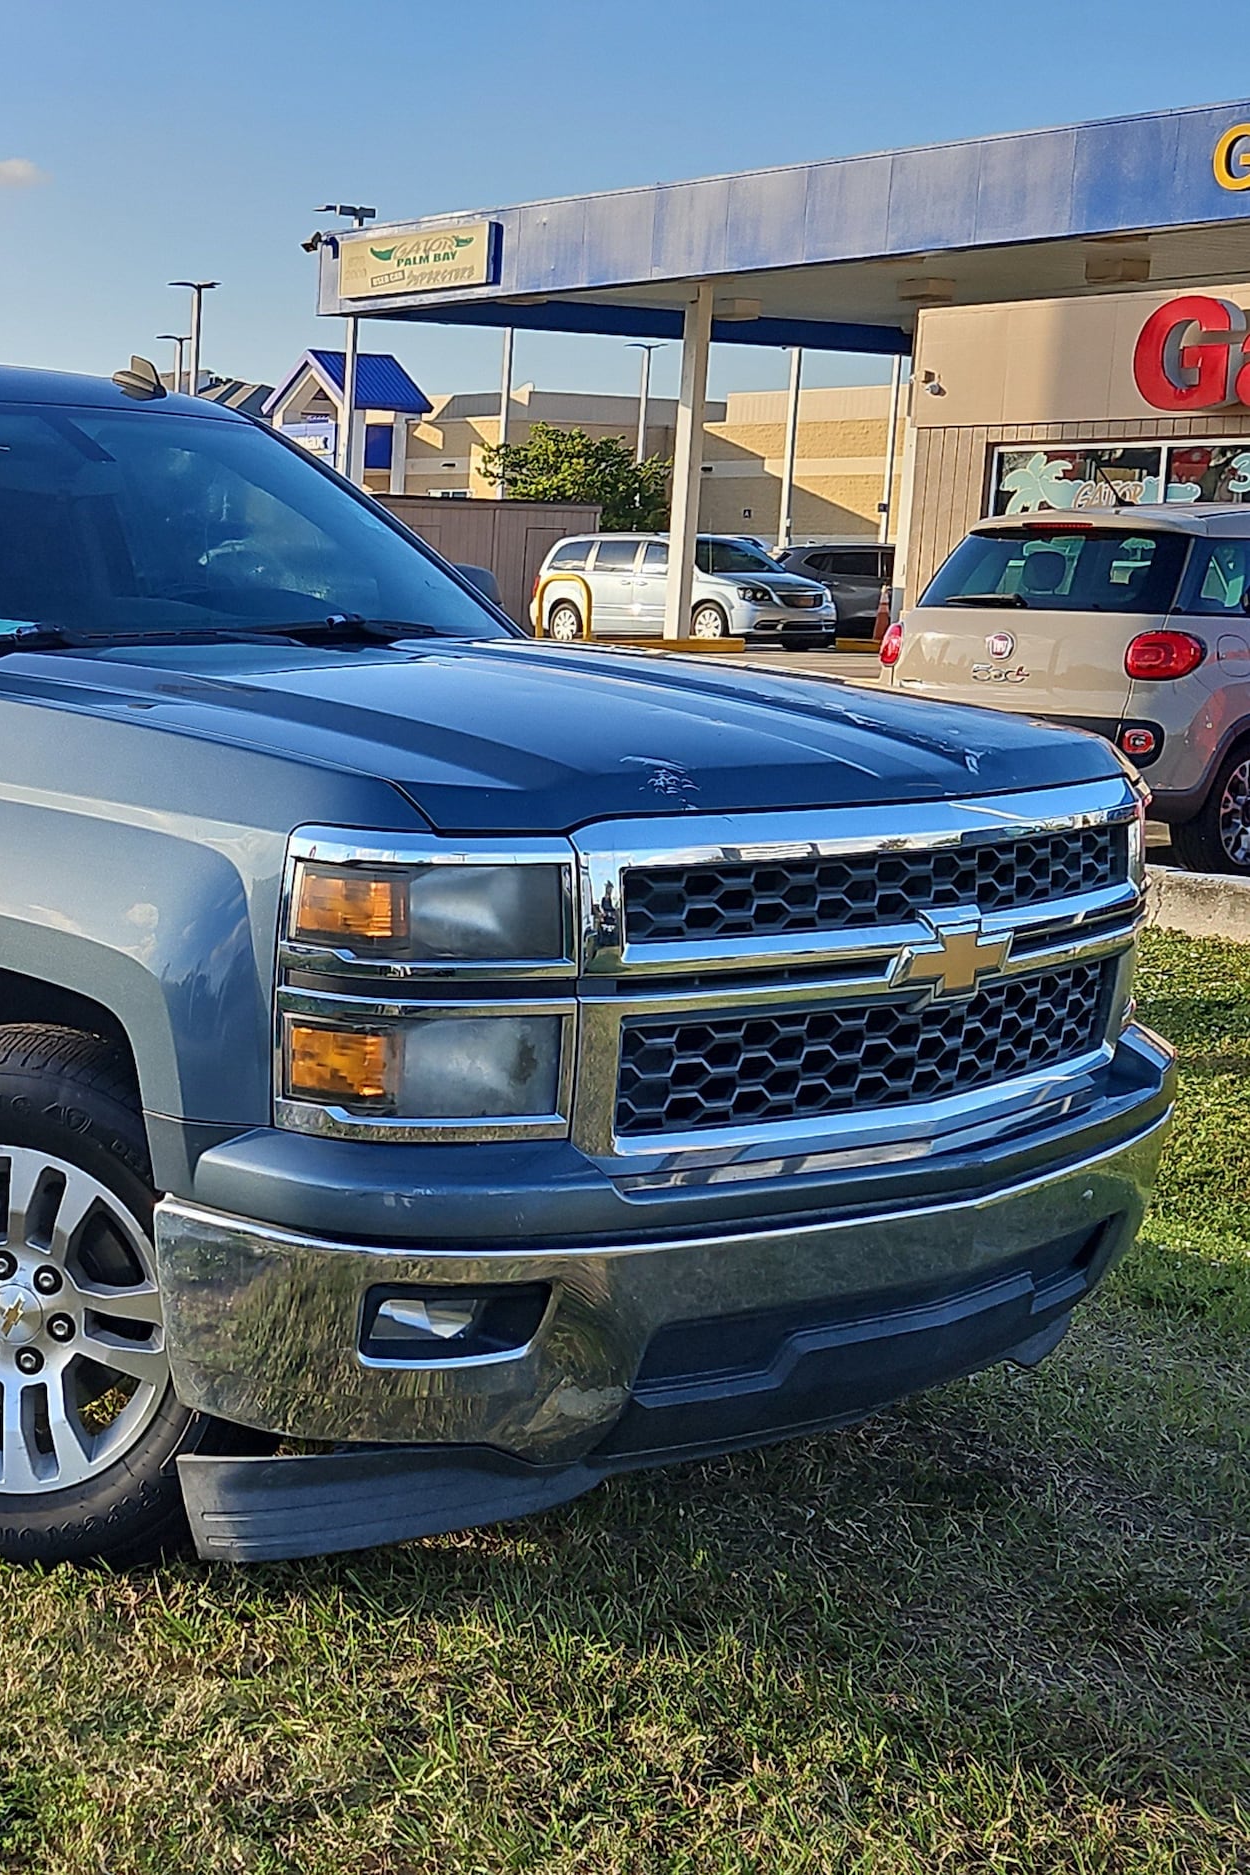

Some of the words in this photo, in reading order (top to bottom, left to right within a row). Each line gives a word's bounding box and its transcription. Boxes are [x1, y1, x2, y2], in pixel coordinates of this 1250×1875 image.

[393, 236, 455, 260] GATOR
[396, 254, 430, 268] PALM
[433, 250, 458, 264] BAY
[1133, 295, 1250, 412] G
[1073, 480, 1144, 508] GATOR
